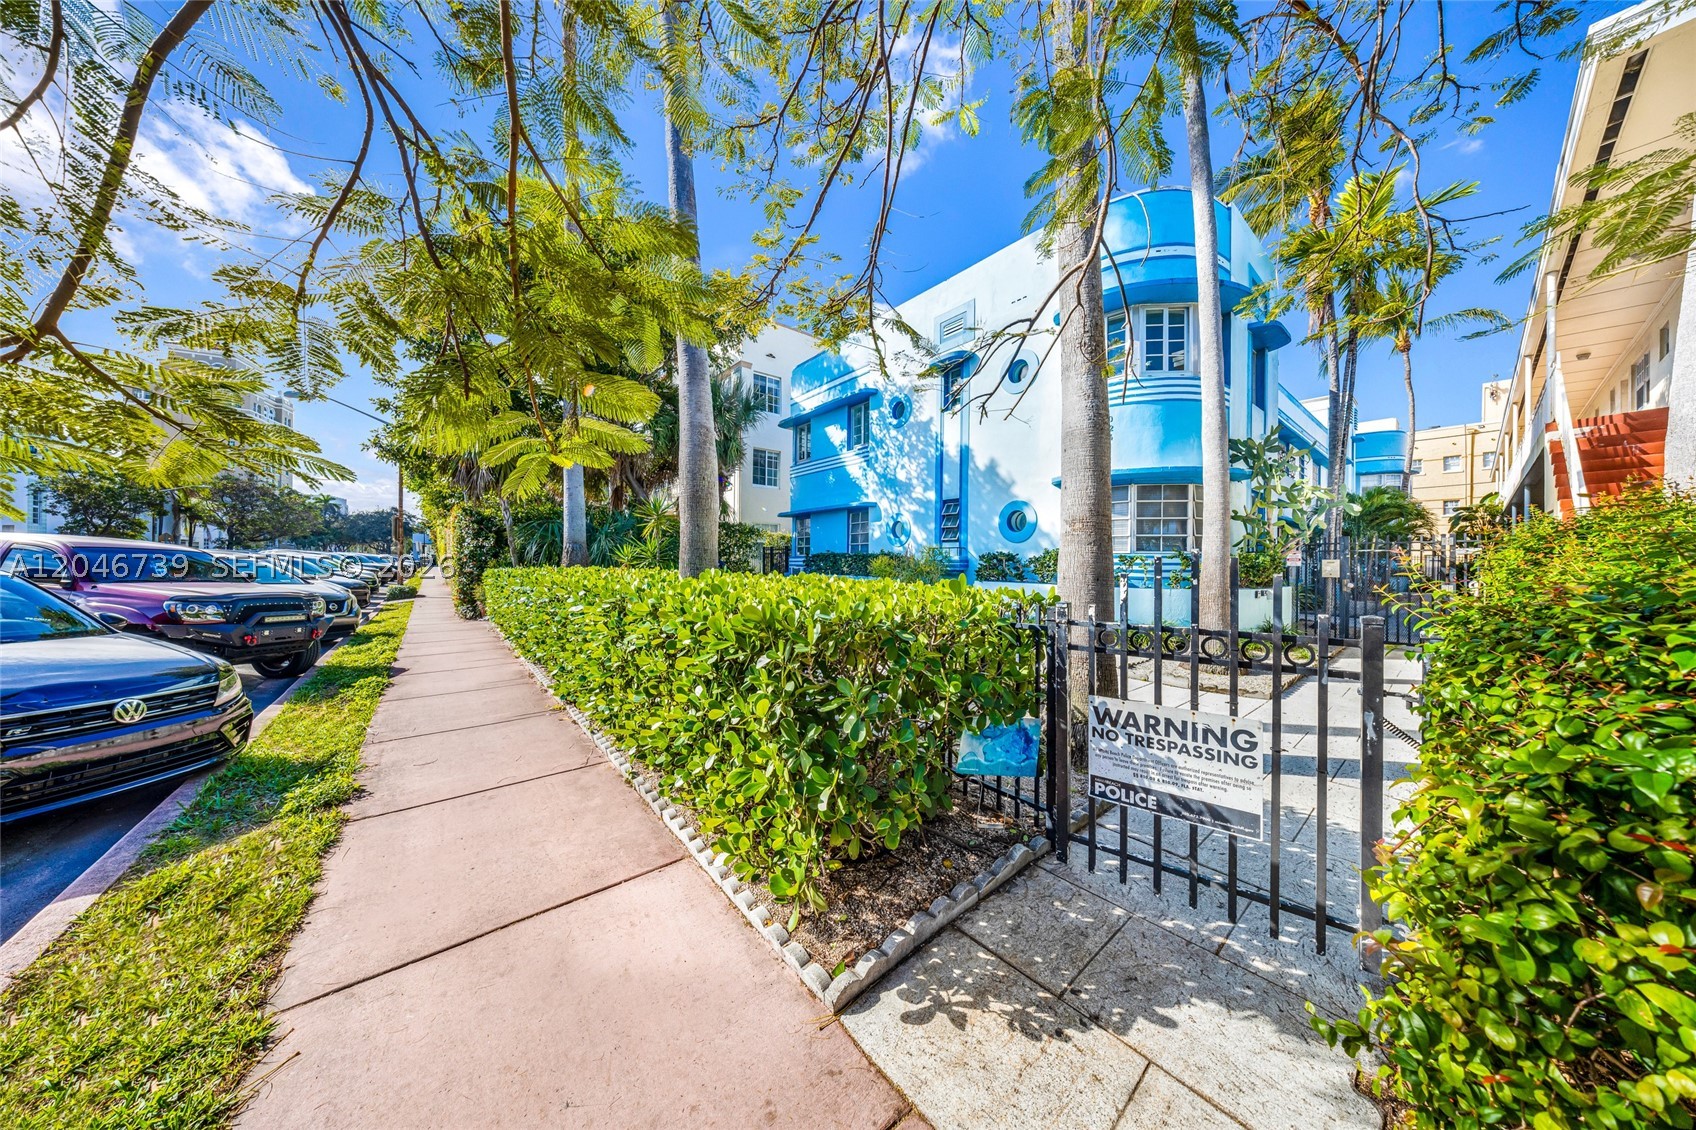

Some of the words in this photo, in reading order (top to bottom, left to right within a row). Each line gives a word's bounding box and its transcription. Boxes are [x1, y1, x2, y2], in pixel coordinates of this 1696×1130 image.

[1093, 706, 1259, 752] WARNING
[1092, 726, 1120, 742] NO
[1125, 732, 1258, 769] TRESPASSING
[1178, 765, 1200, 774] authorized
[1200, 770, 1233, 781] representatives
[1094, 781, 1157, 810] POLICE
